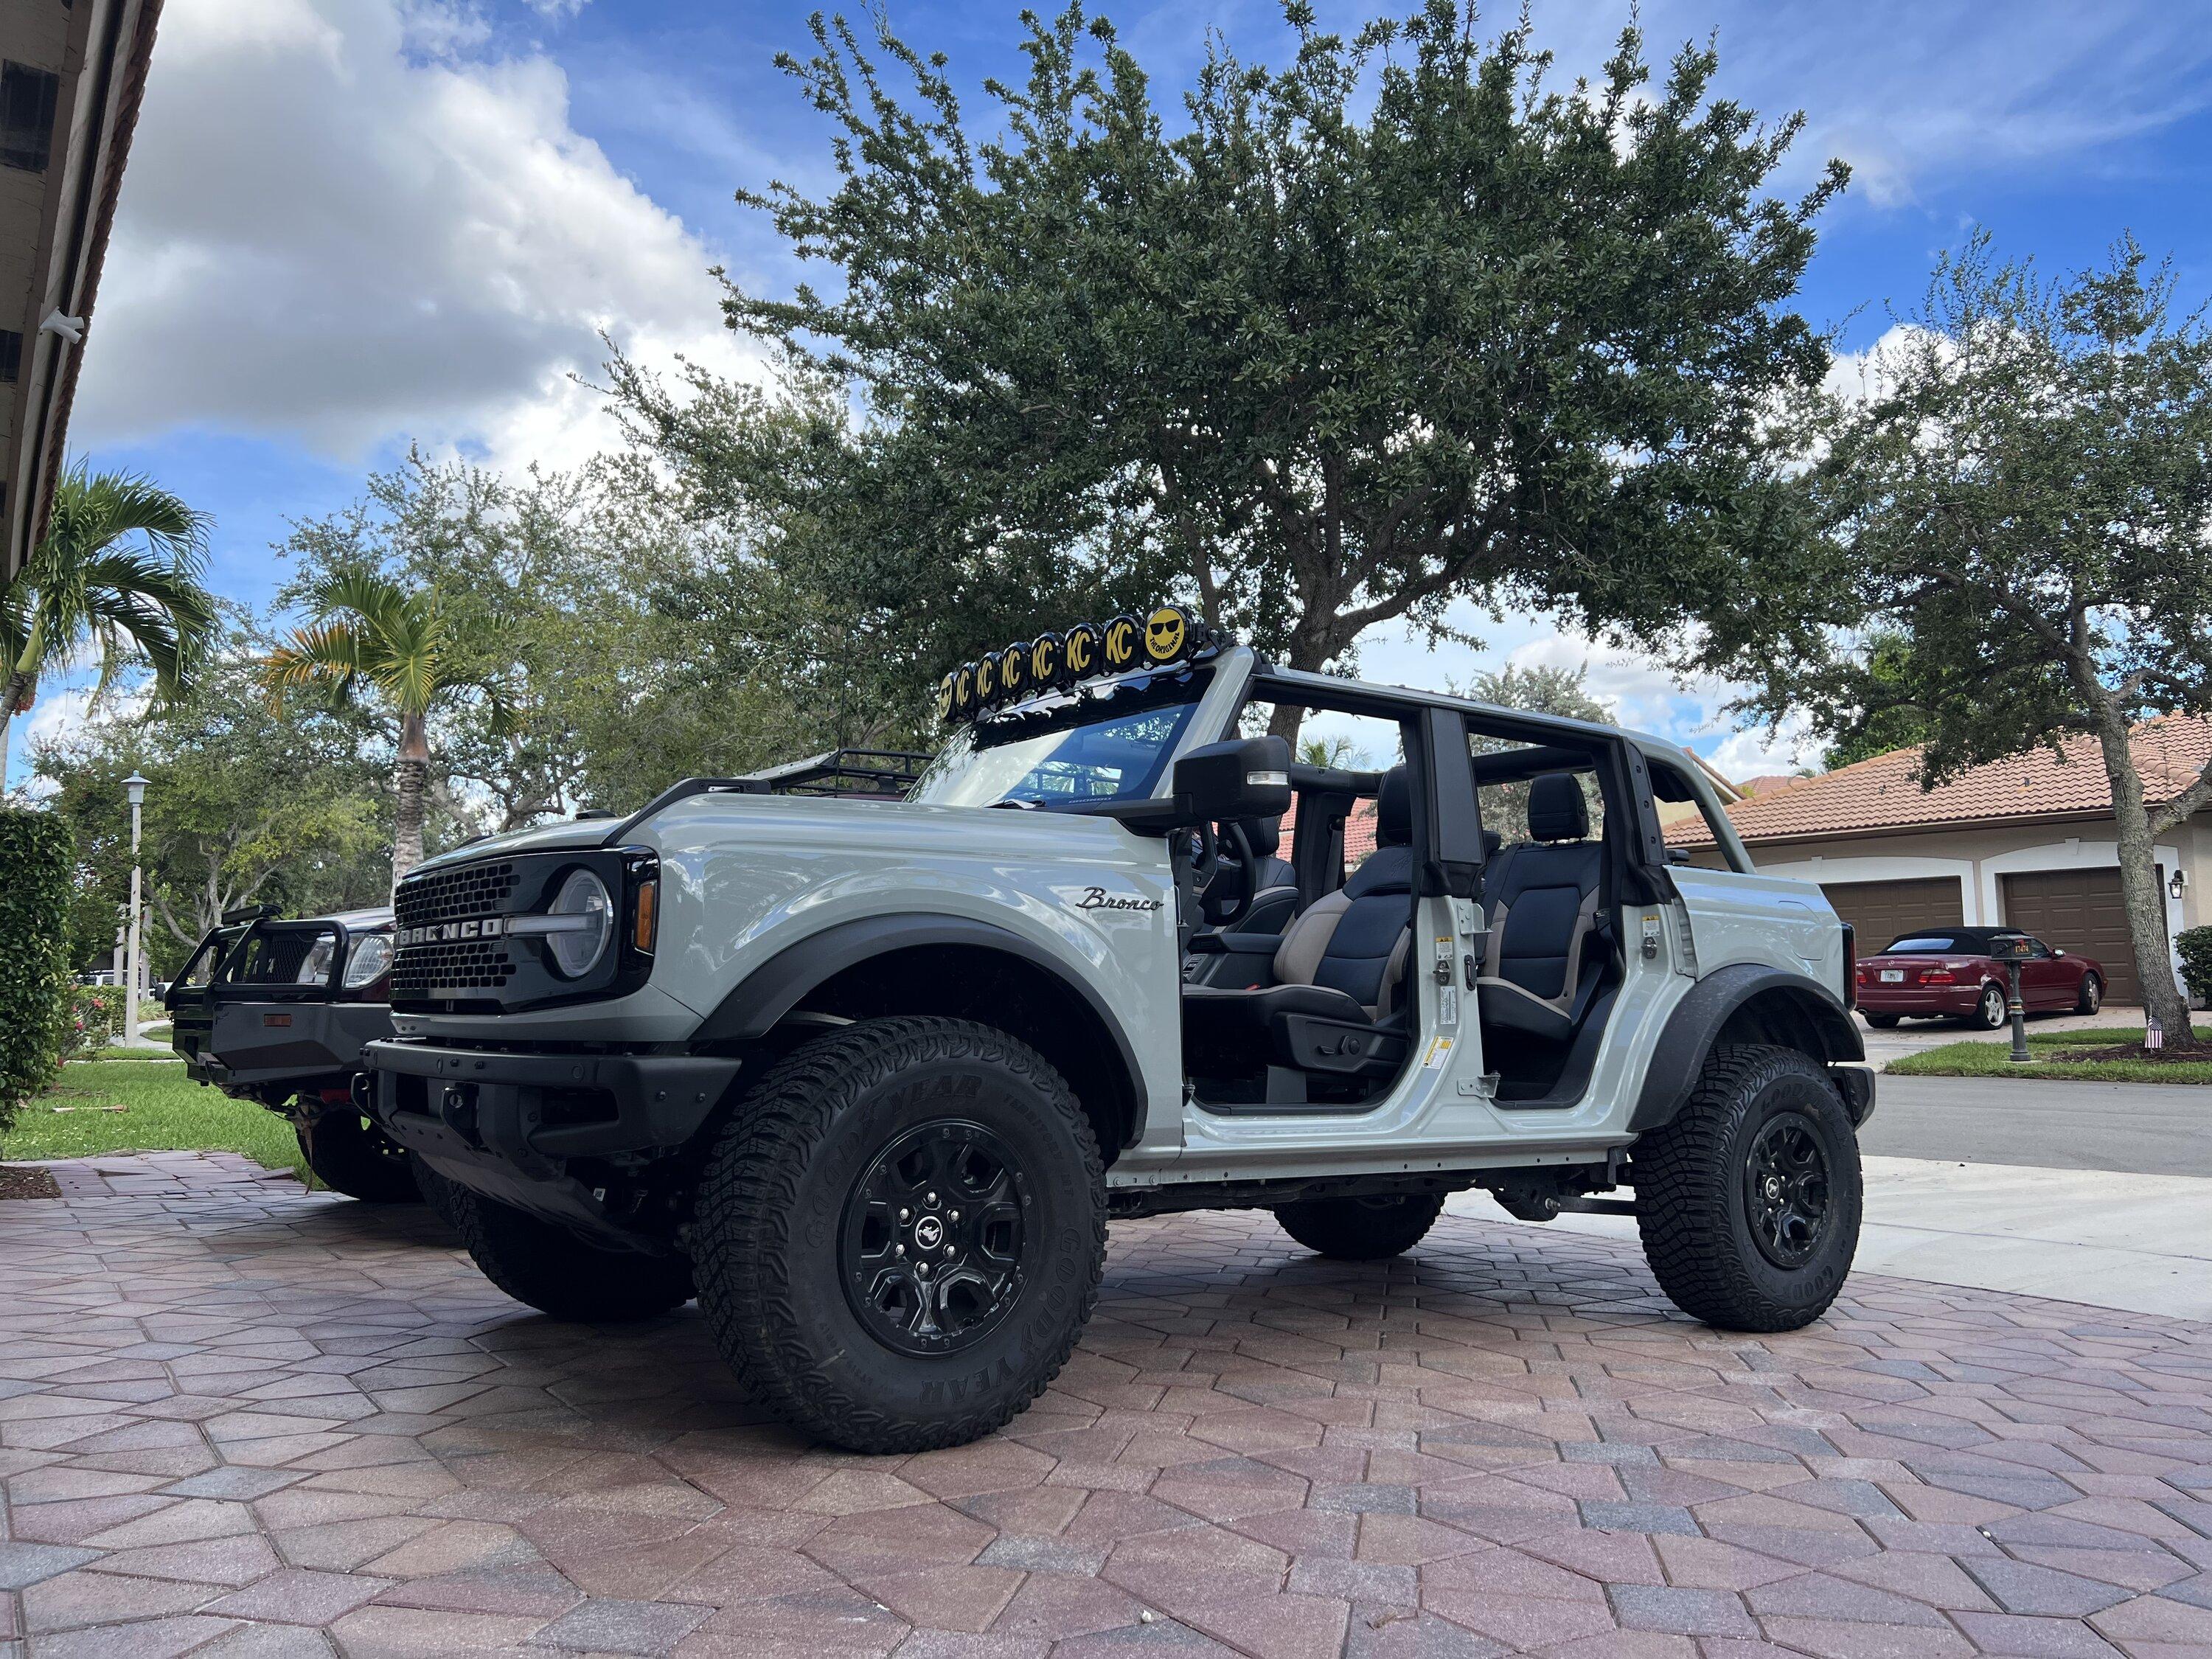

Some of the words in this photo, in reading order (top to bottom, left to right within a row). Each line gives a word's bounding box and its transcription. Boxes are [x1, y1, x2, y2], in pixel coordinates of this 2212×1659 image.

[1032, 639, 1053, 680] KC
[1067, 630, 1091, 672] KC
[1107, 622, 1133, 664] KC
[1155, 632, 1180, 654] ORIGINAL
[956, 669, 970, 706] KC
[977, 659, 992, 698] KC
[1002, 650, 1020, 688] KC
[1075, 886, 1164, 911] Bronco
[399, 918, 504, 945] BRONCO
